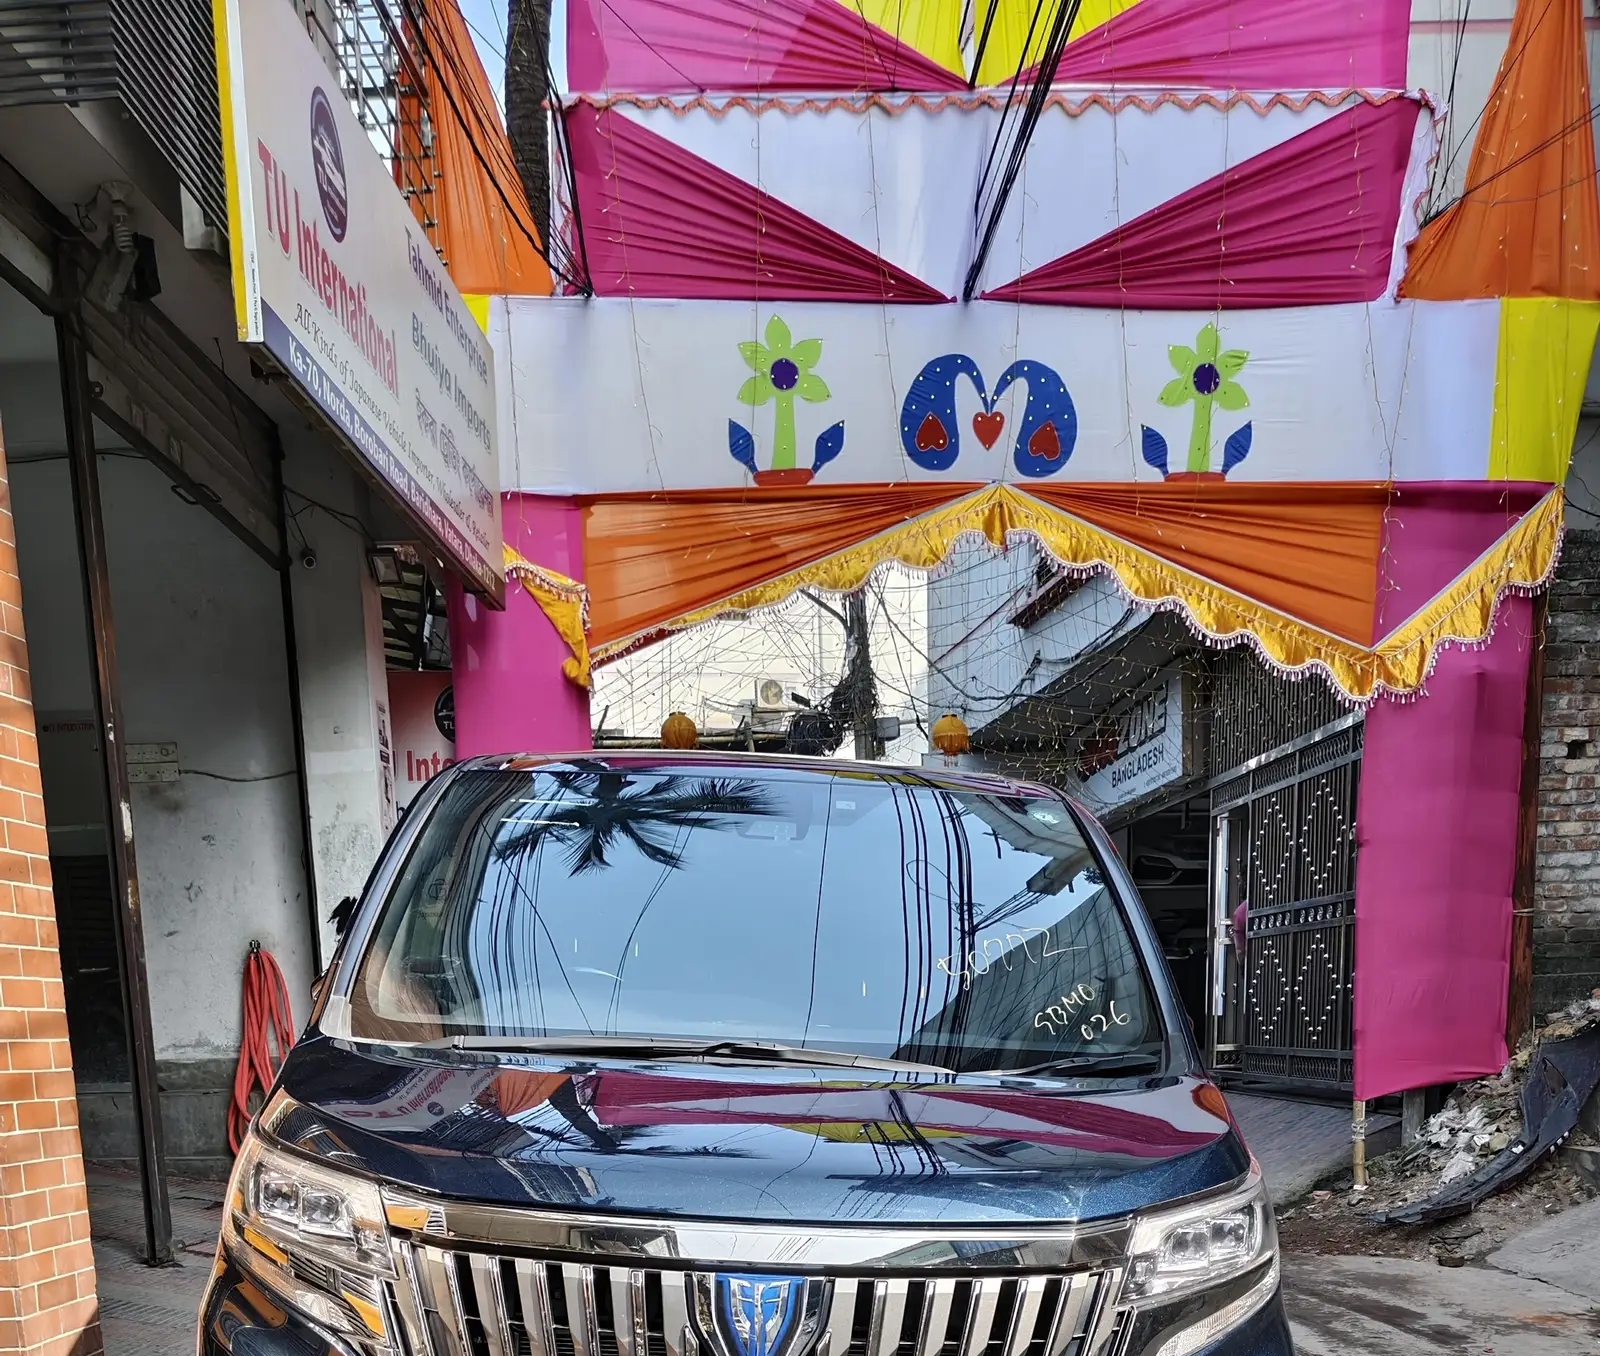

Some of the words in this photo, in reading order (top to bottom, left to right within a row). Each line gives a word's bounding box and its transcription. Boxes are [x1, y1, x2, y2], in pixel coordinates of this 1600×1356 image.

[257, 137, 290, 255] TU
[293, 186, 399, 396] International
[405, 224, 444, 315] Tahmid
[444, 290, 488, 386] Enterprise
[294, 303, 312, 334] All
[312, 321, 338, 368] Kinds
[339, 360, 350, 385] of
[349, 367, 383, 423] Japanese
[383, 411, 407, 453] Vehicle
[412, 311, 451, 396] Bhuiya
[454, 373, 491, 452] Imports
[288, 335, 322, 397] Ka-70,
[322, 375, 353, 434] Norda,
[354, 412, 389, 471] Borobari
[389, 456, 410, 500] Road,
[410, 479, 444, 537] Baridhara,
[443, 517, 465, 560] Vatara,
[465, 541, 496, 591] Dhaka-1212
[1111, 742, 1165, 789] BANGLADESH
[1081, 1000, 1132, 1041] 026
